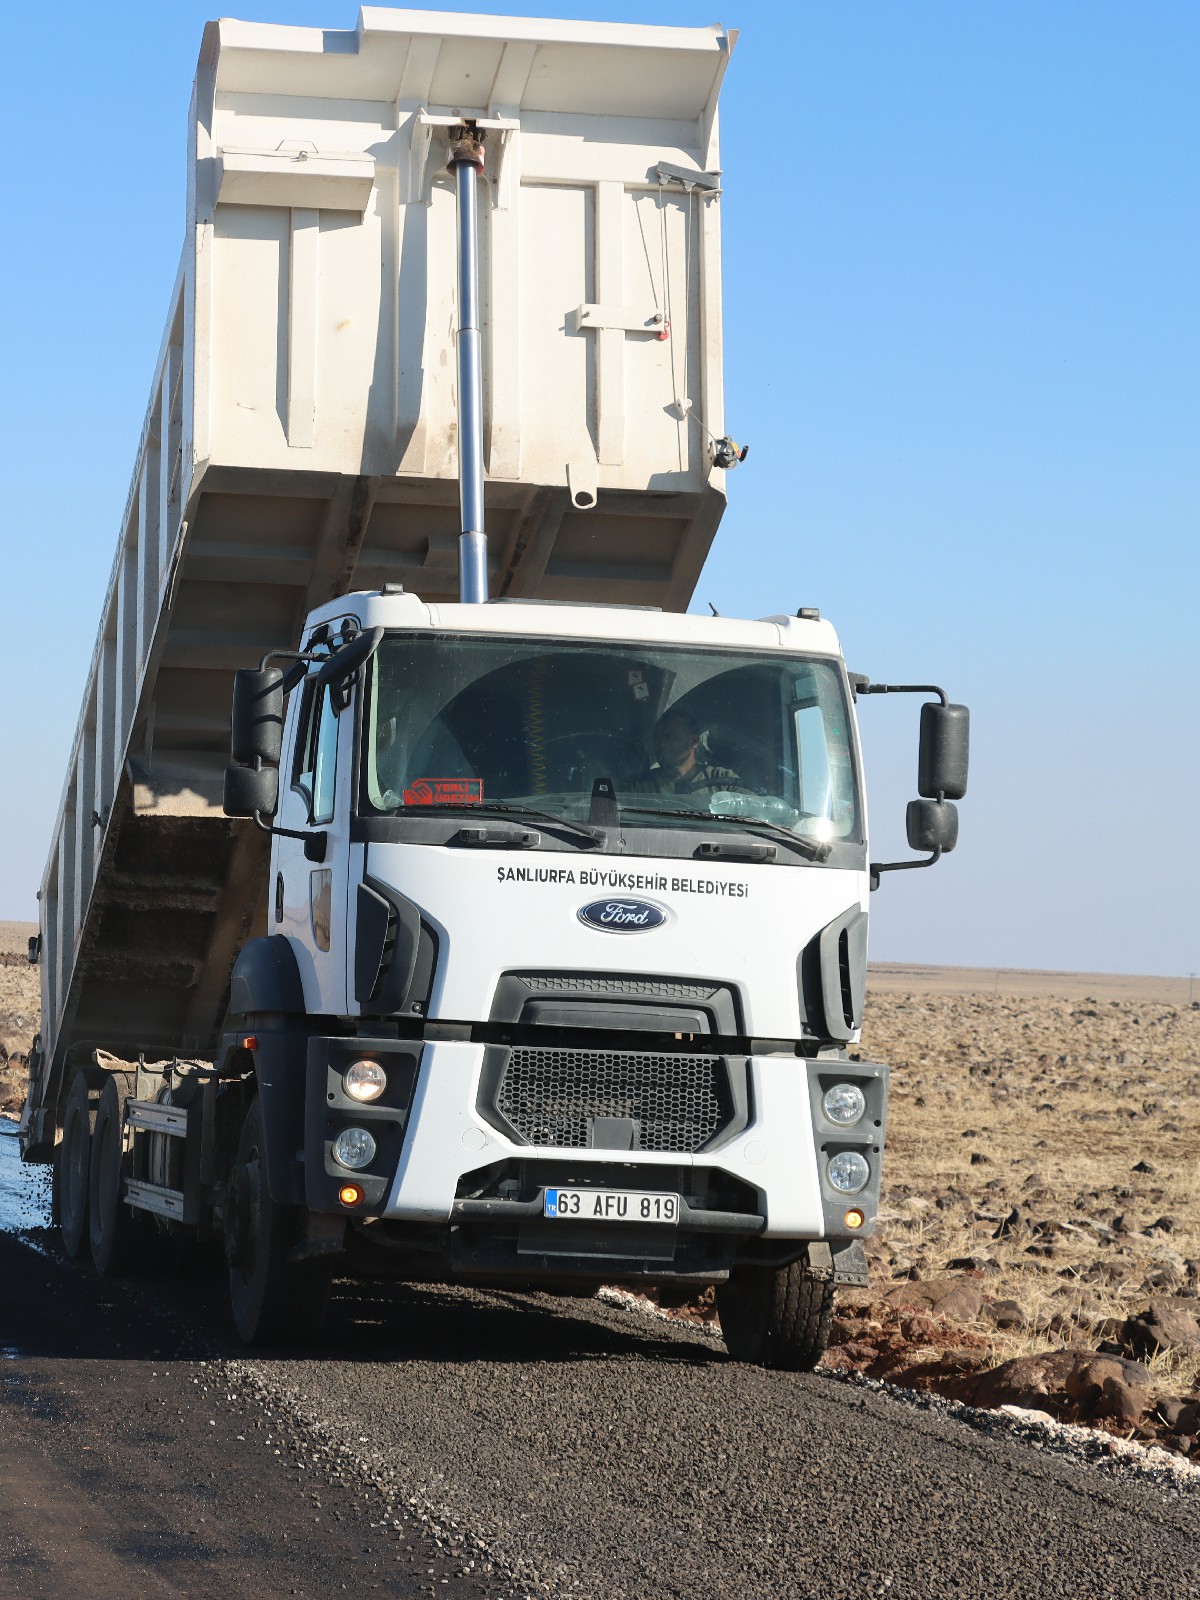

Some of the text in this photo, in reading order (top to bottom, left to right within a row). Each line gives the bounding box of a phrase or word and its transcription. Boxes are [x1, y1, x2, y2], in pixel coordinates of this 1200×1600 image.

[434, 782, 469, 792] YERLİ
[497, 866, 749, 898] ŞANLIURFA BÜYÜKŞEHİR BELEDİYESİ
[600, 902, 650, 926] Ford
[547, 1193, 675, 1220] TR 63 AFU 819
